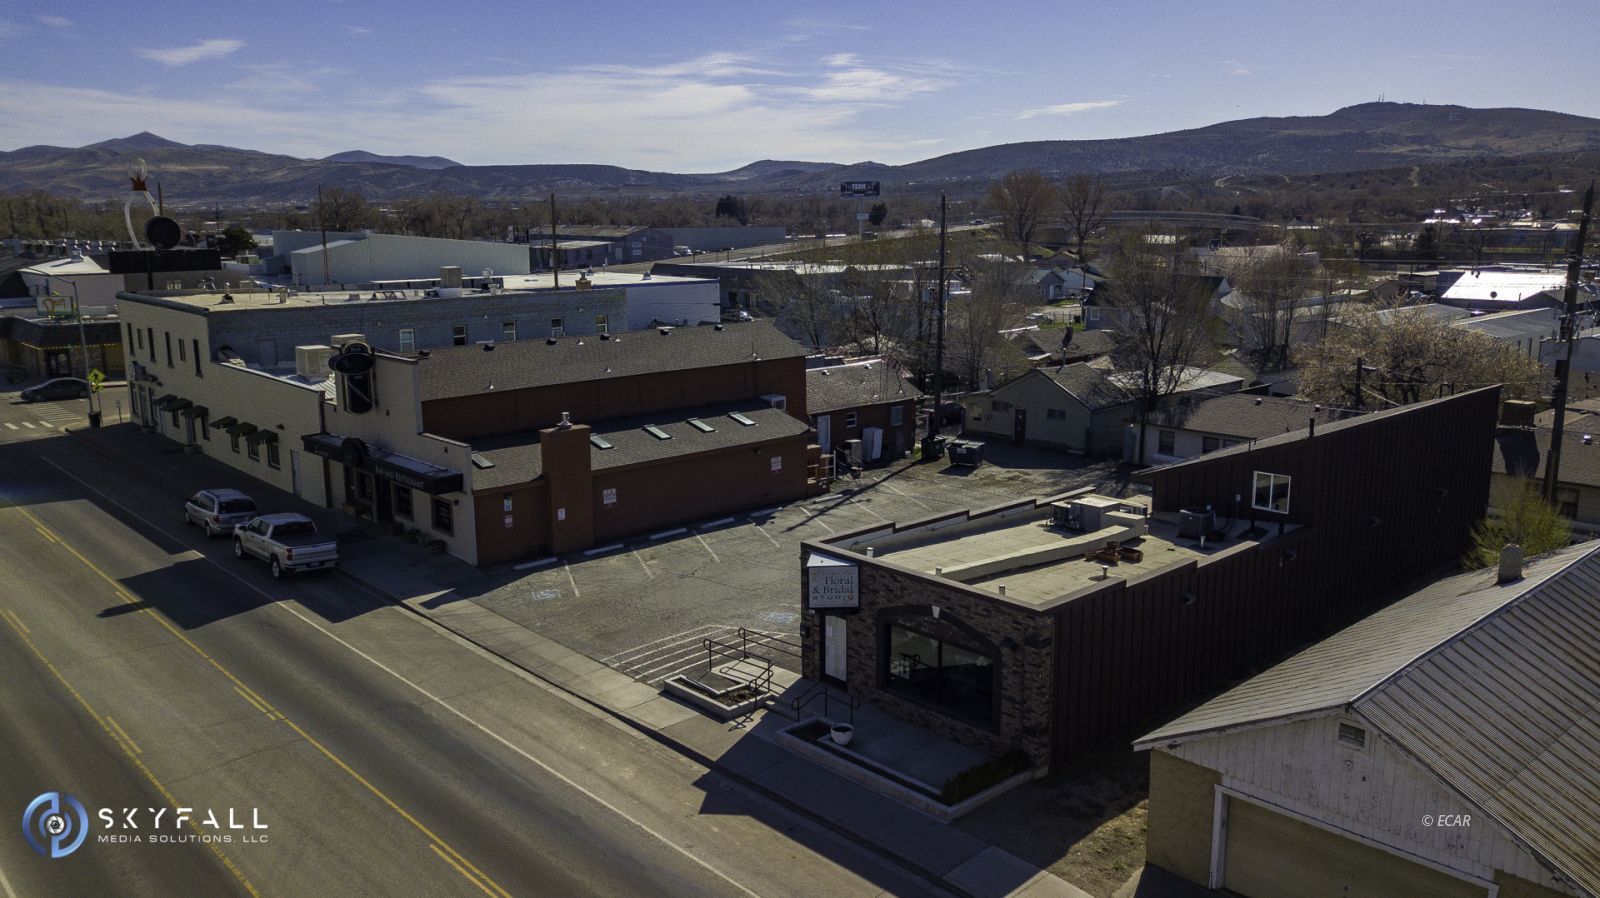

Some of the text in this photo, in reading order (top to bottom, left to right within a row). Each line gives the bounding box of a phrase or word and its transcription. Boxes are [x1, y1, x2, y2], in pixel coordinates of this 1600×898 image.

[825, 576, 853, 585] Floral
[812, 585, 853, 594] & Bridal
